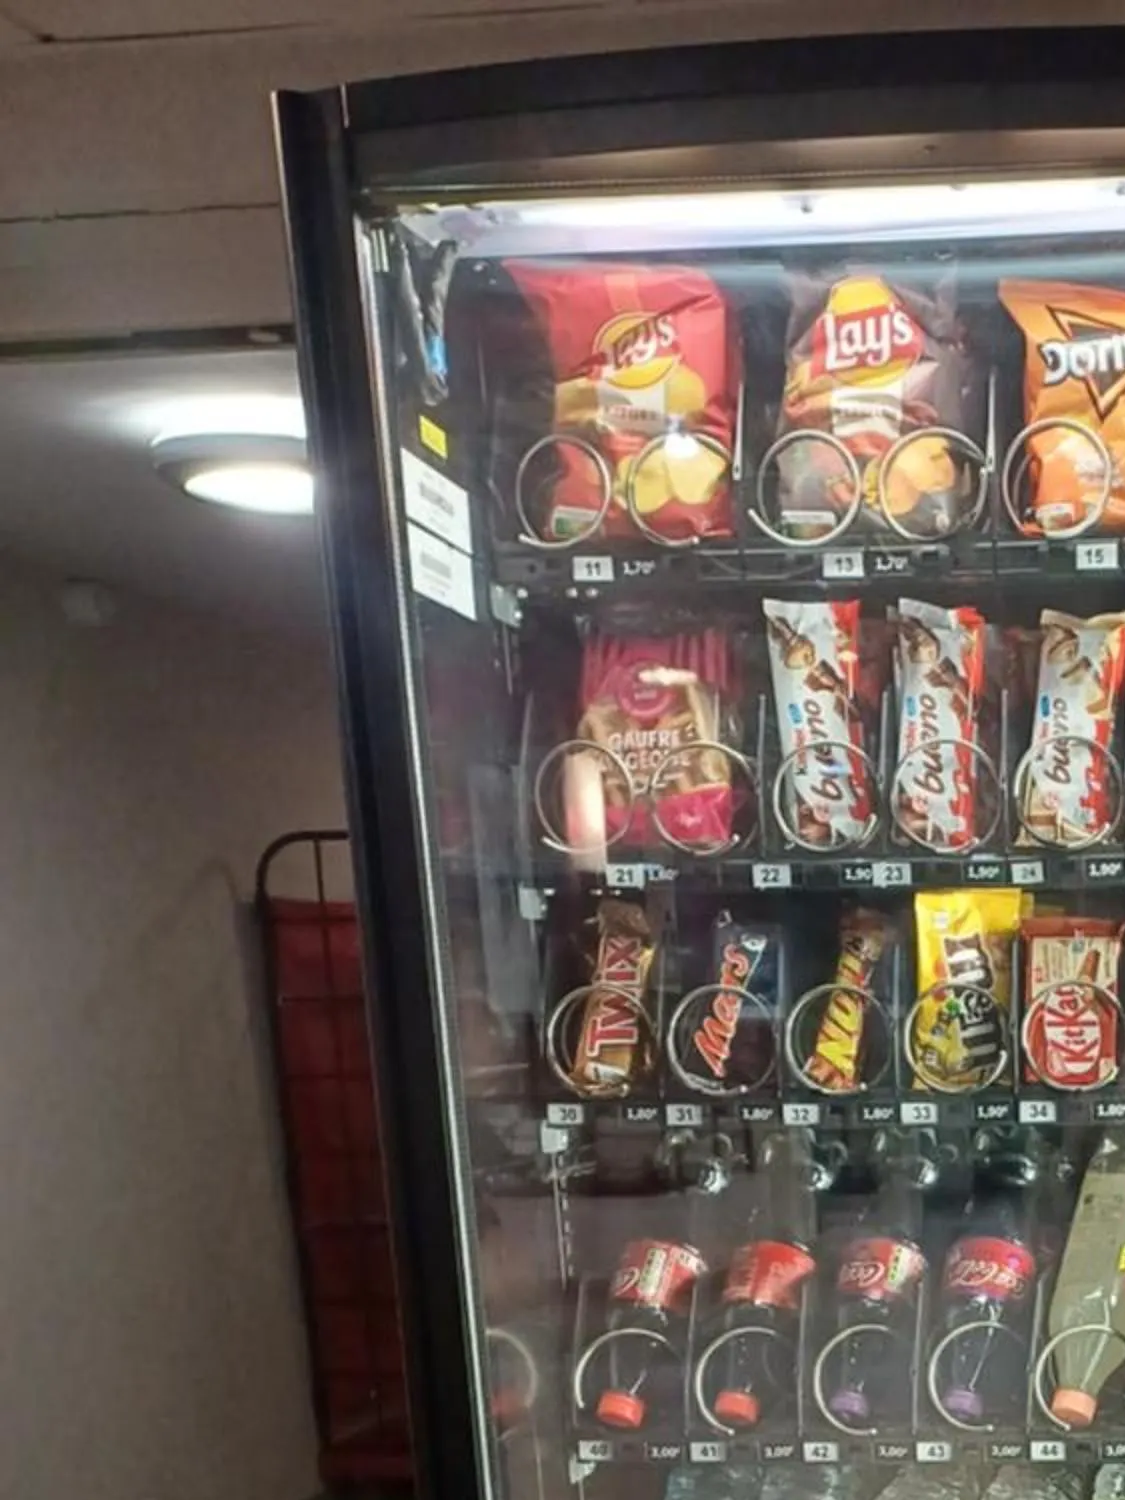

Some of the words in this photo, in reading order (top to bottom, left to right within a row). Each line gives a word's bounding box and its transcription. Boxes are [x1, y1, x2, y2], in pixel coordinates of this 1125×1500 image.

[816, 302, 913, 371] Lay's
[1084, 547, 1105, 565] 15
[584, 560, 601, 576] 11
[834, 556, 854, 573] 13
[914, 694, 944, 794] bueno
[1044, 697, 1072, 784] bueno
[615, 868, 634, 883] 21
[761, 868, 780, 883] 22
[884, 866, 903, 881] 23
[585, 935, 641, 1056] TWIX
[676, 1108, 693, 1122] 31
[791, 1107, 809, 1121] 32
[913, 1106, 931, 1120] 33
[1029, 1104, 1048, 1118] 34
[700, 1444, 718, 1457] 41
[811, 1444, 829, 1458] 42
[927, 1444, 945, 1458] 43
[1040, 1443, 1059, 1457] 44
